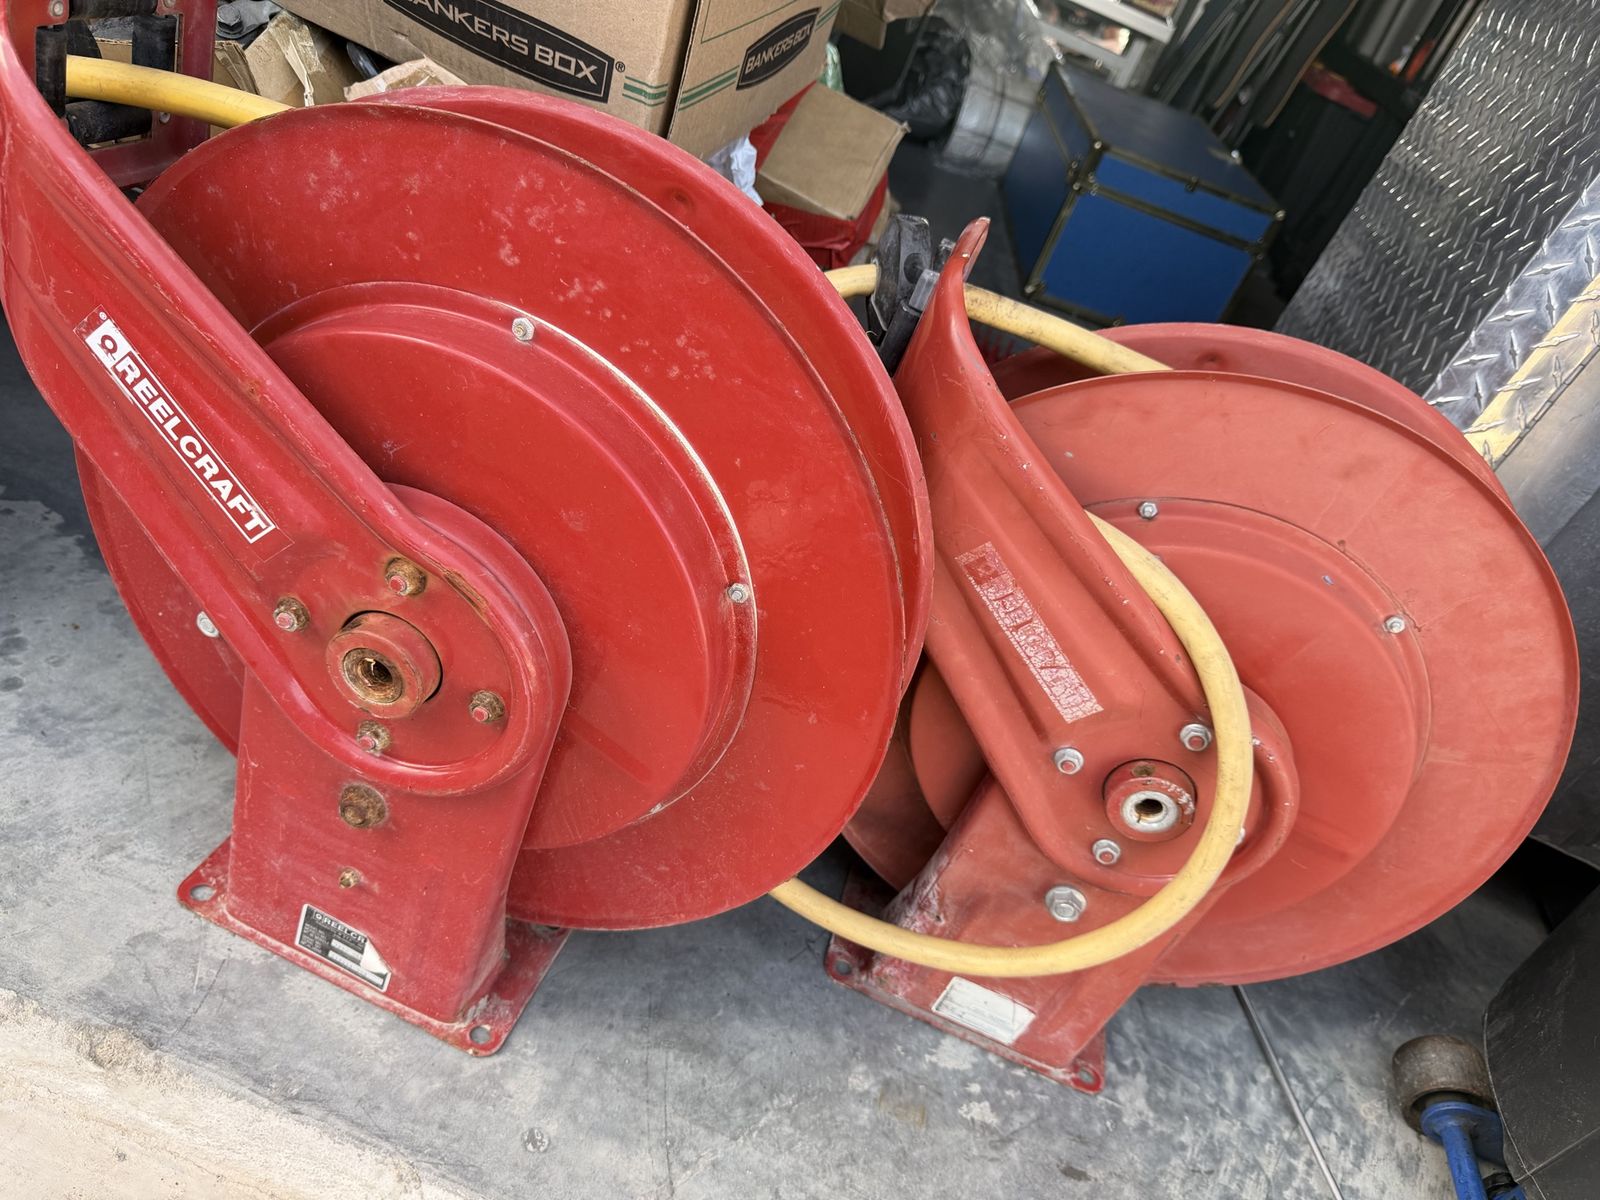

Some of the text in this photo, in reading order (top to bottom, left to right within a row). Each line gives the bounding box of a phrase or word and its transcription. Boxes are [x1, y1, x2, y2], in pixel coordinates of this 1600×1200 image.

[407, 0, 598, 85] ANKERS BOX
[744, 33, 795, 75] BANKERS
[115, 355, 267, 531] REELCRAFT
[324, 917, 366, 943] REELCR
